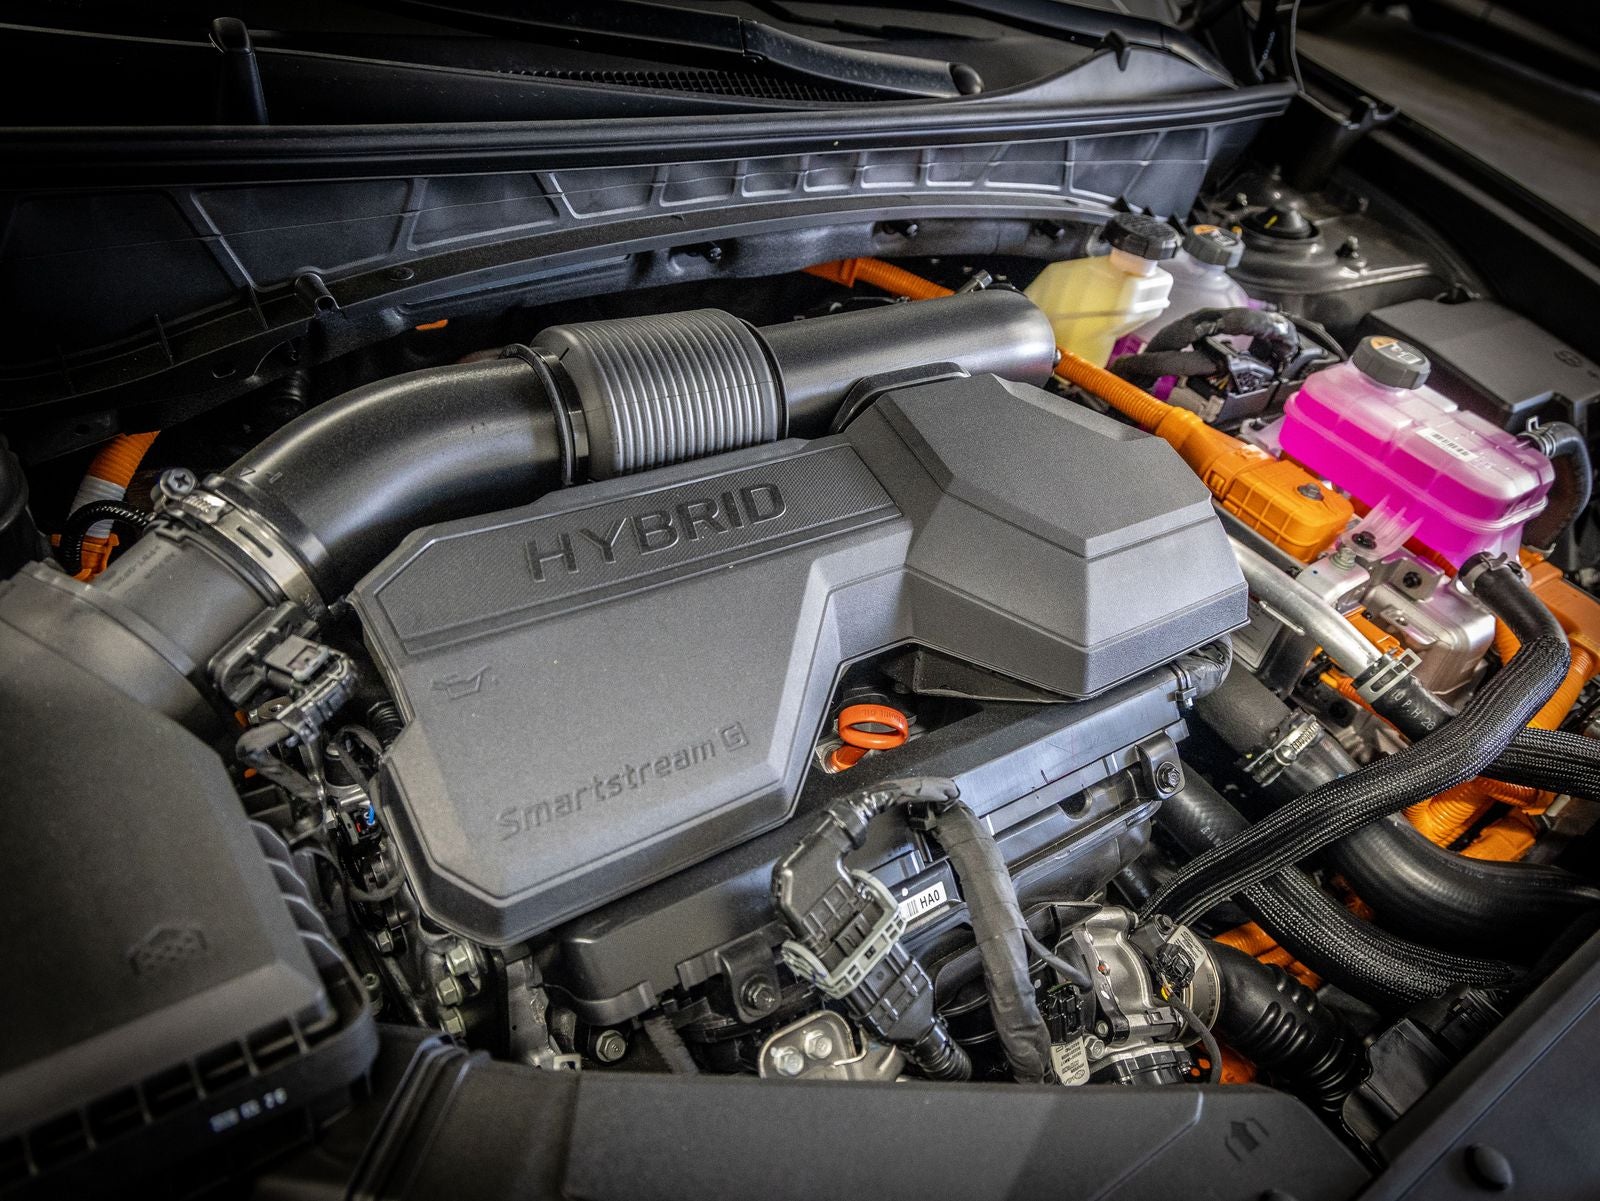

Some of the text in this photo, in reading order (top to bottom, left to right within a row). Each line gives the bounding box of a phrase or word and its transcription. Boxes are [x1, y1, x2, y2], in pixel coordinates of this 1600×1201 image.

[524, 482, 787, 583] HYBRID
[496, 721, 750, 841] Smartstream G
